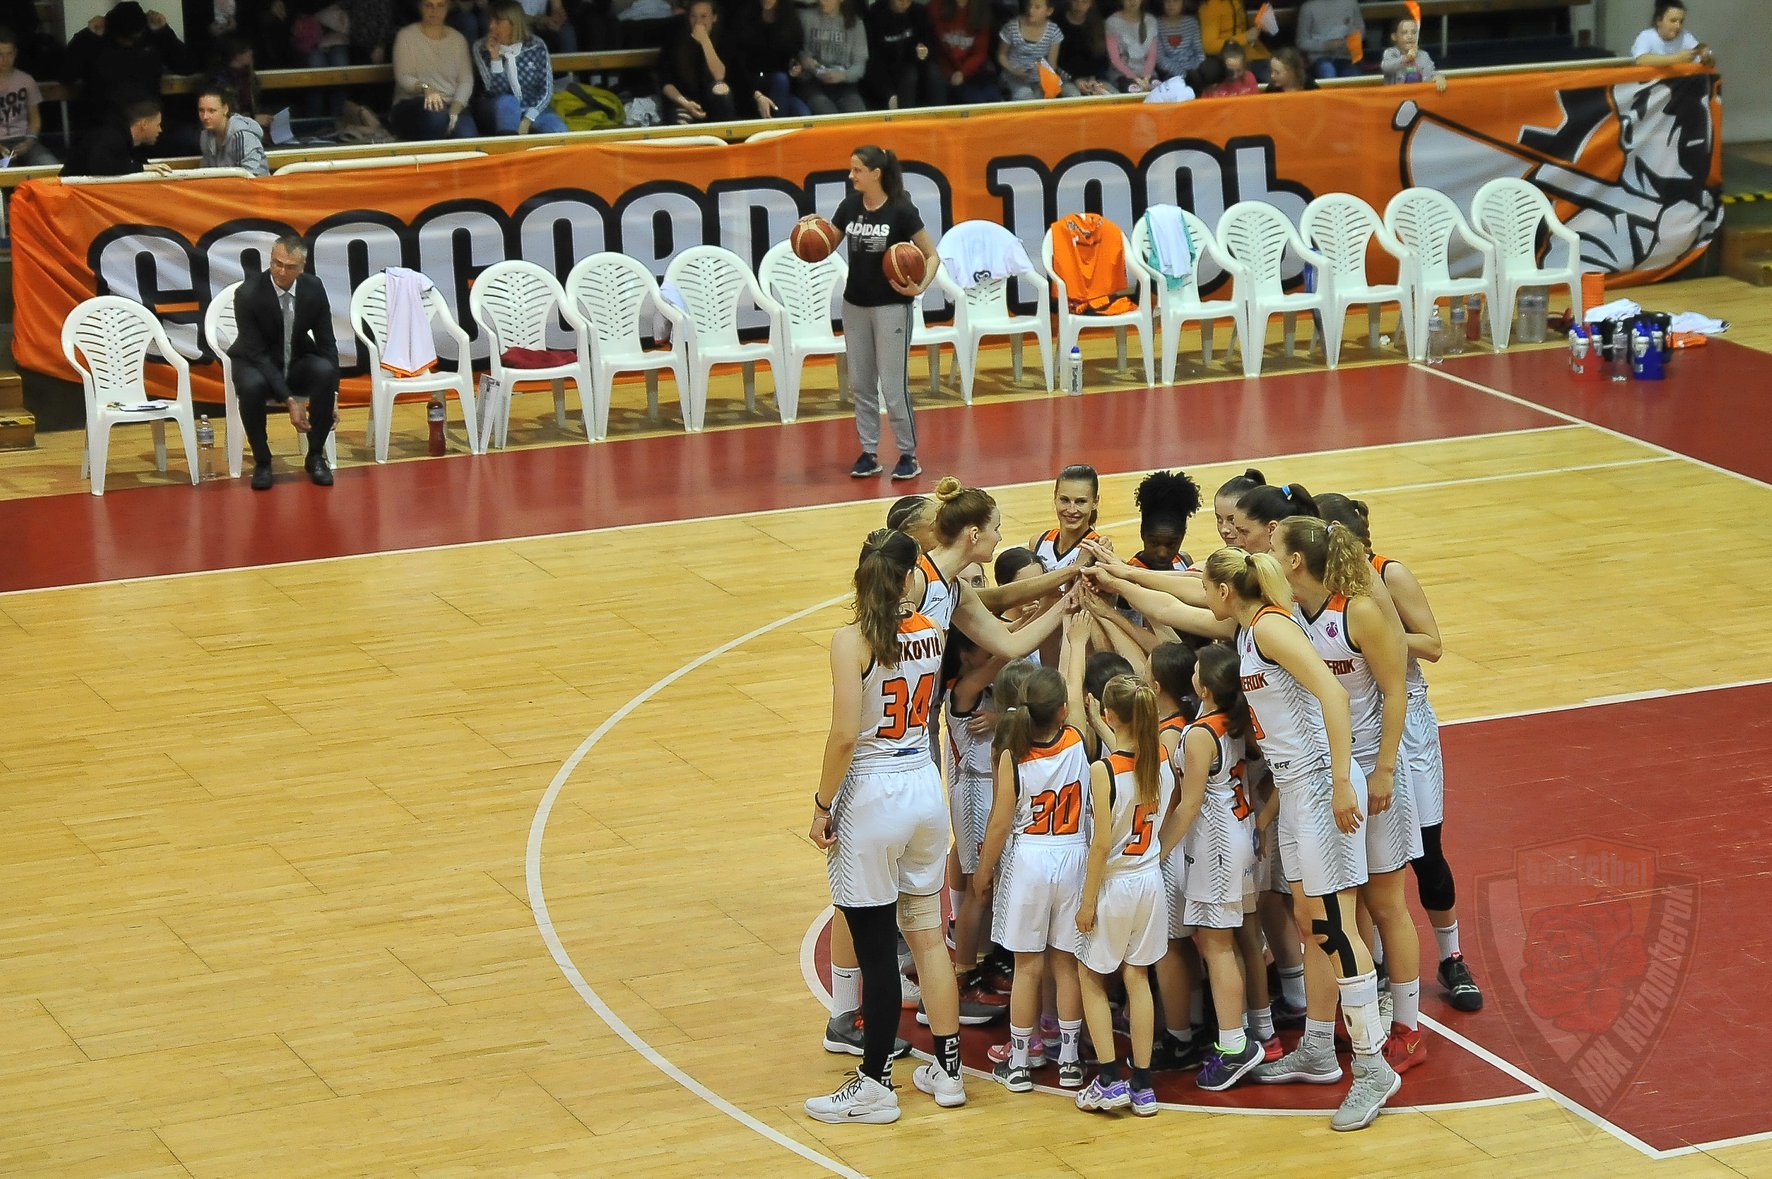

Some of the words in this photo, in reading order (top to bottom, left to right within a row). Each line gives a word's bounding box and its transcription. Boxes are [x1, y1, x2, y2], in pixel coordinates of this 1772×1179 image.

[846, 221, 890, 237] ADIDAS
[1323, 659, 1356, 675] EROK
[875, 672, 935, 740] 34
[1023, 780, 1082, 836] 30
[1122, 803, 1158, 857] 5
